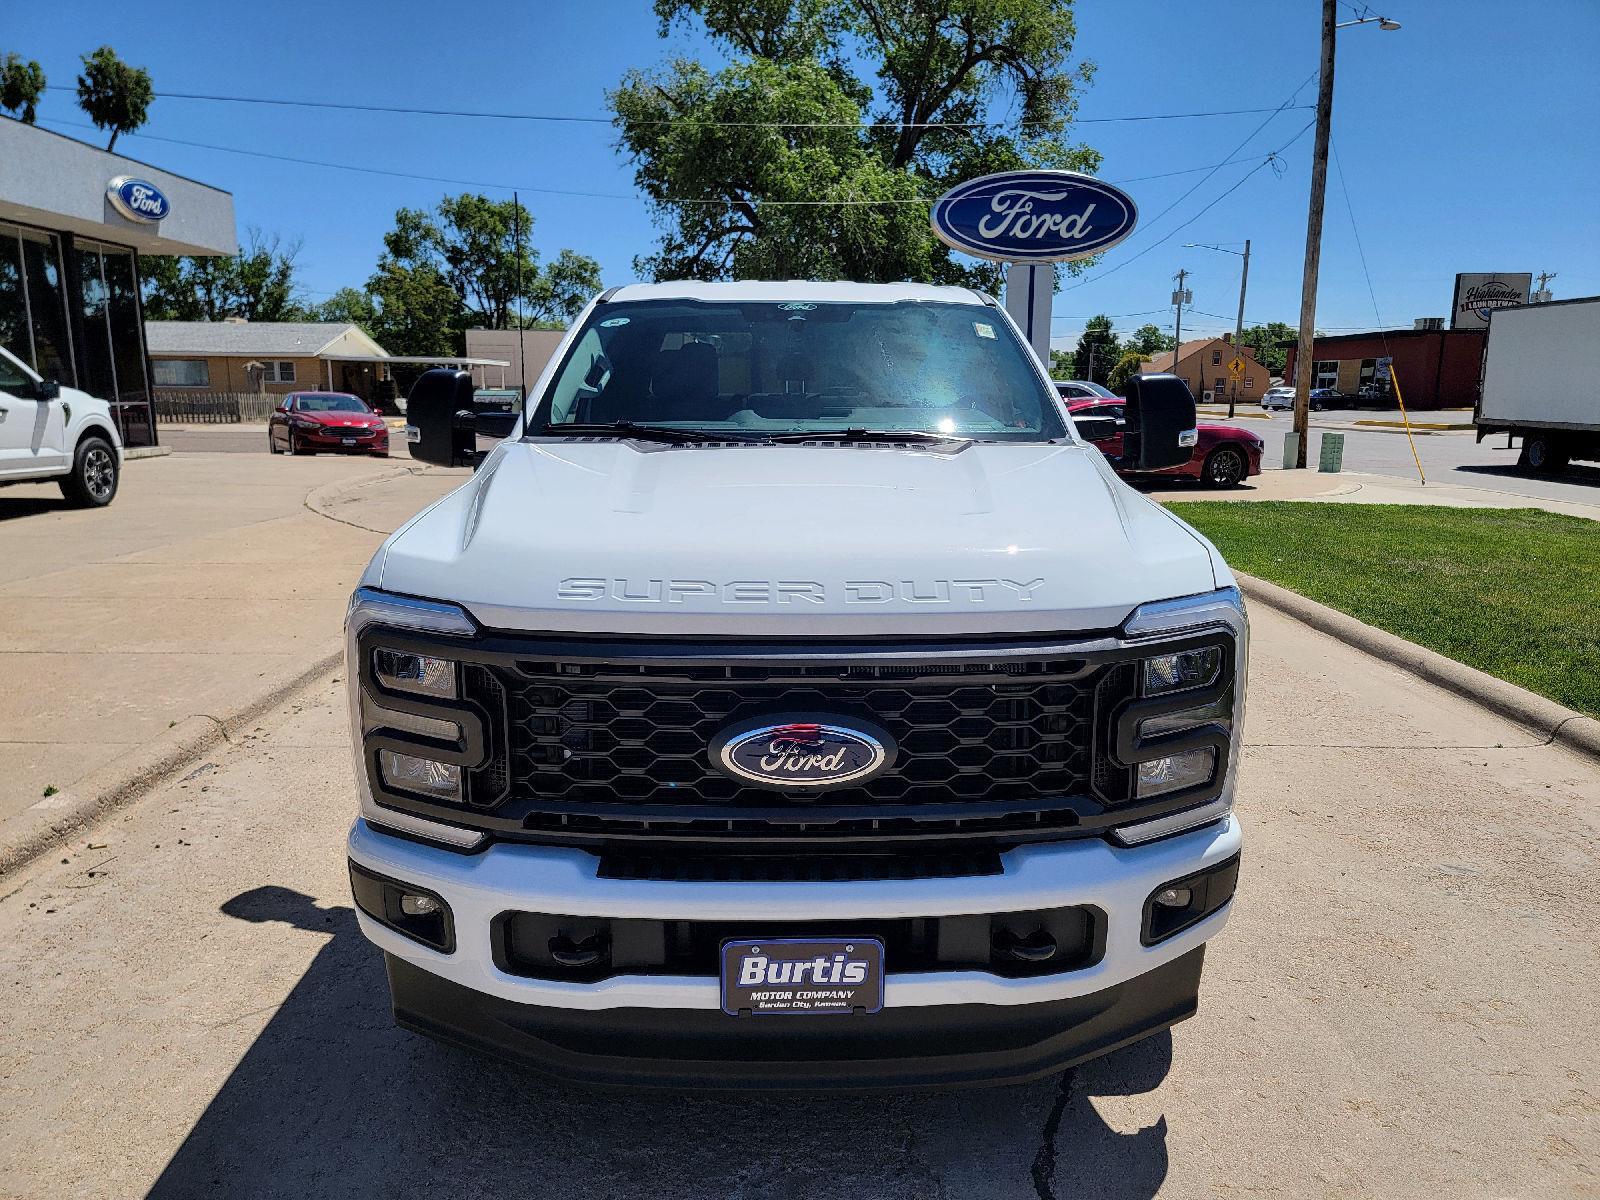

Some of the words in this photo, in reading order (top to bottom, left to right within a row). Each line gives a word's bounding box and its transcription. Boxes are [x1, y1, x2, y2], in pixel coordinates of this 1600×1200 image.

[130, 185, 163, 214] Ford
[978, 189, 1097, 239] Ford
[1465, 286, 1522, 301] Highlander
[557, 577, 825, 604] SUPER
[845, 577, 1045, 604] DUTY
[760, 737, 847, 772] Ford
[739, 955, 868, 985] Burtis
[750, 991, 793, 1001] MOTOR
[796, 990, 855, 1000] COMPANY
